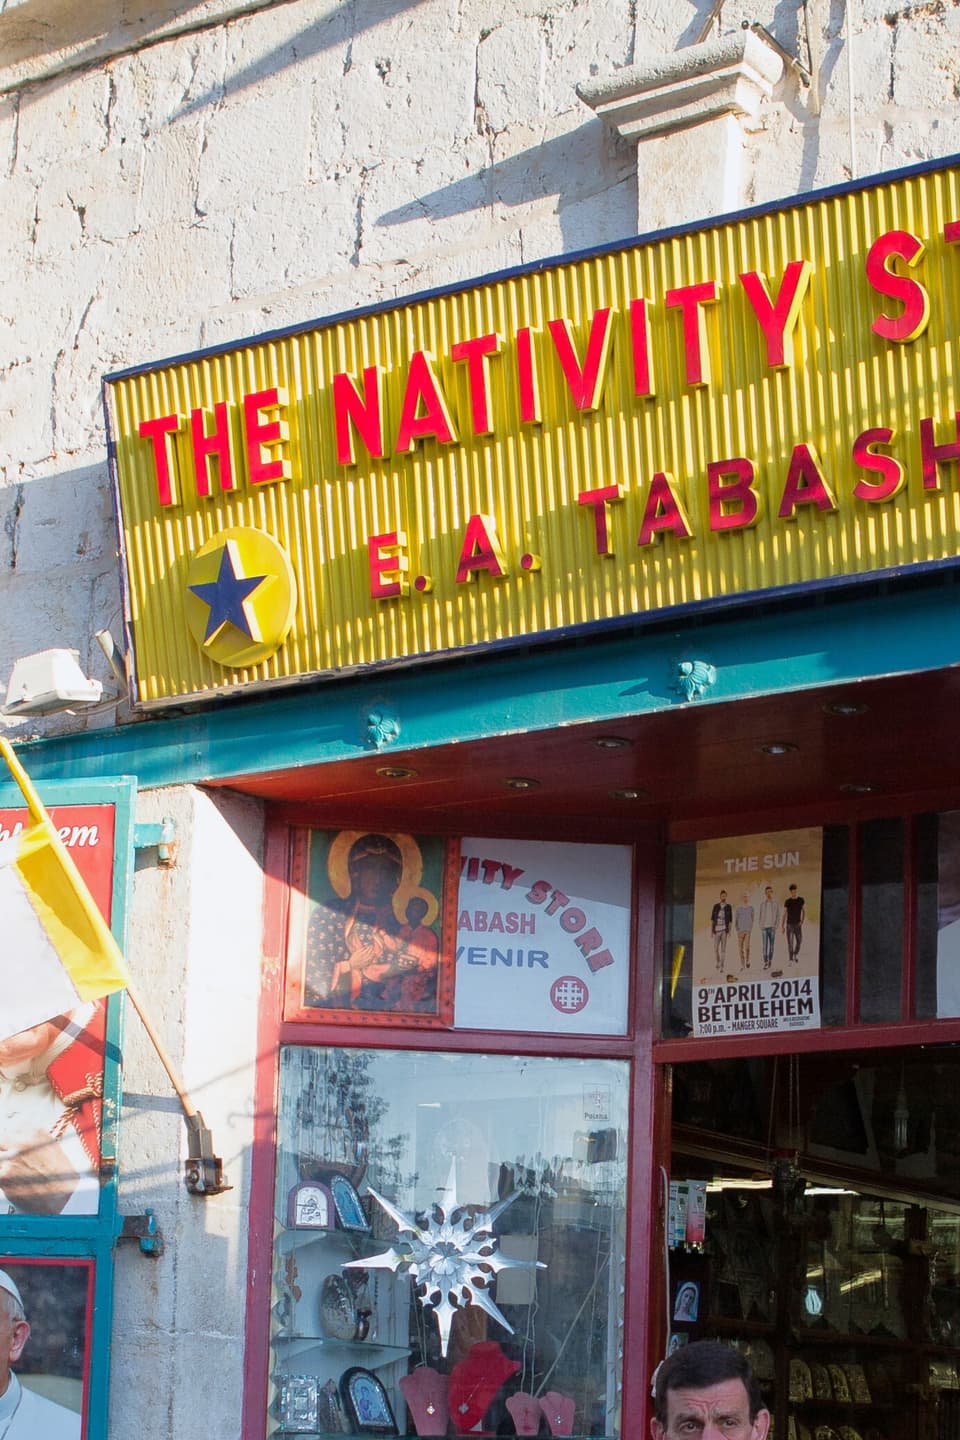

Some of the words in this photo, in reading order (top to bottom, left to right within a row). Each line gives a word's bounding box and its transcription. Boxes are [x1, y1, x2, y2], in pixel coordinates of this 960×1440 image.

[139, 387, 291, 507] THE
[333, 260, 812, 466] NATIVITY
[368, 531, 432, 599] E.
[456, 515, 541, 584] A.
[724, 854, 759, 873] THE
[763, 850, 800, 871] SUN
[526, 880, 615, 973] STORE
[714, 983, 765, 1004] APRIL
[770, 979, 812, 999] 2014
[698, 997, 814, 1023] BETHLEHEM
[732, 1019, 757, 1031] MANGER
[757, 1018, 779, 1030] SQUARE
